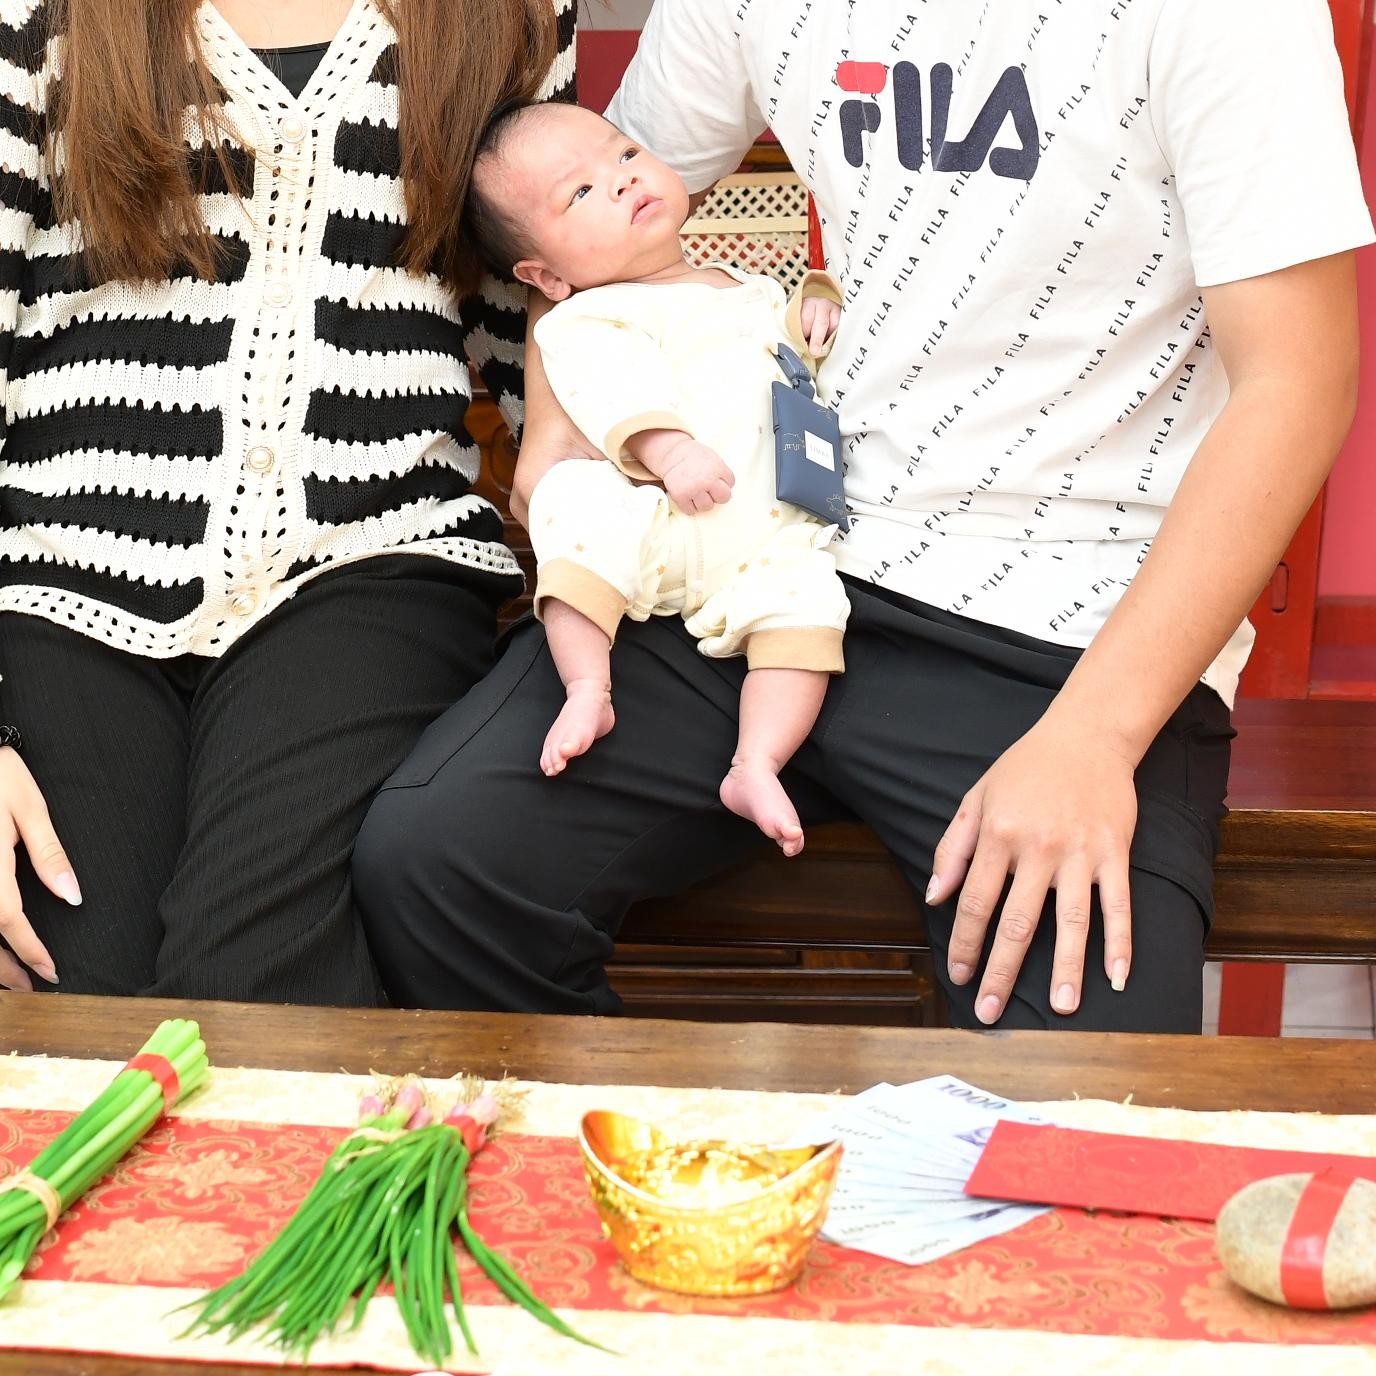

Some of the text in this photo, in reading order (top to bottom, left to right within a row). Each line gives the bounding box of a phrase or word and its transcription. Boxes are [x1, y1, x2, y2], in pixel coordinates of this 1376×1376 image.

[774, 51, 790, 86] FILA
[791, 3, 811, 38] FILA
[891, 15, 917, 51] FILA
[1027, 15, 1048, 50] FILA
[811, 100, 832, 136] FILA
[836, 61, 1040, 180] FILA
[1058, 85, 1091, 119] FILA
[1120, 96, 1146, 129] FILA
[845, 210, 859, 244] FILA
[859, 163, 871, 198] FILA
[864, 233, 889, 268] FILA
[889, 185, 913, 221] FILA
[847, 347, 867, 379] FILA
[869, 302, 892, 336] FILA
[893, 257, 919, 291] FILA
[921, 209, 949, 245] FILA
[900, 364, 923, 390] FILA
[923, 320, 948, 355] FILA
[952, 274, 976, 309] FILA
[980, 228, 1004, 263] FILA
[907, 445, 927, 476] FILA
[932, 405, 963, 438] FILA
[973, 366, 1004, 396] FILA
[1005, 333, 1029, 357] FILA
[1030, 285, 1057, 320] FILA
[1057, 241, 1084, 274] FILA
[1085, 192, 1111, 228] FILA
[1079, 349, 1107, 379] FILA
[1109, 300, 1136, 336] FILA
[1136, 254, 1163, 287] FILA
[1150, 343, 1178, 379] FILA
[1150, 418, 1173, 455] FILA
[1173, 363, 1196, 402] FILA
[1049, 602, 1085, 631] FILA
[937, 1083, 1007, 1109] 1000
